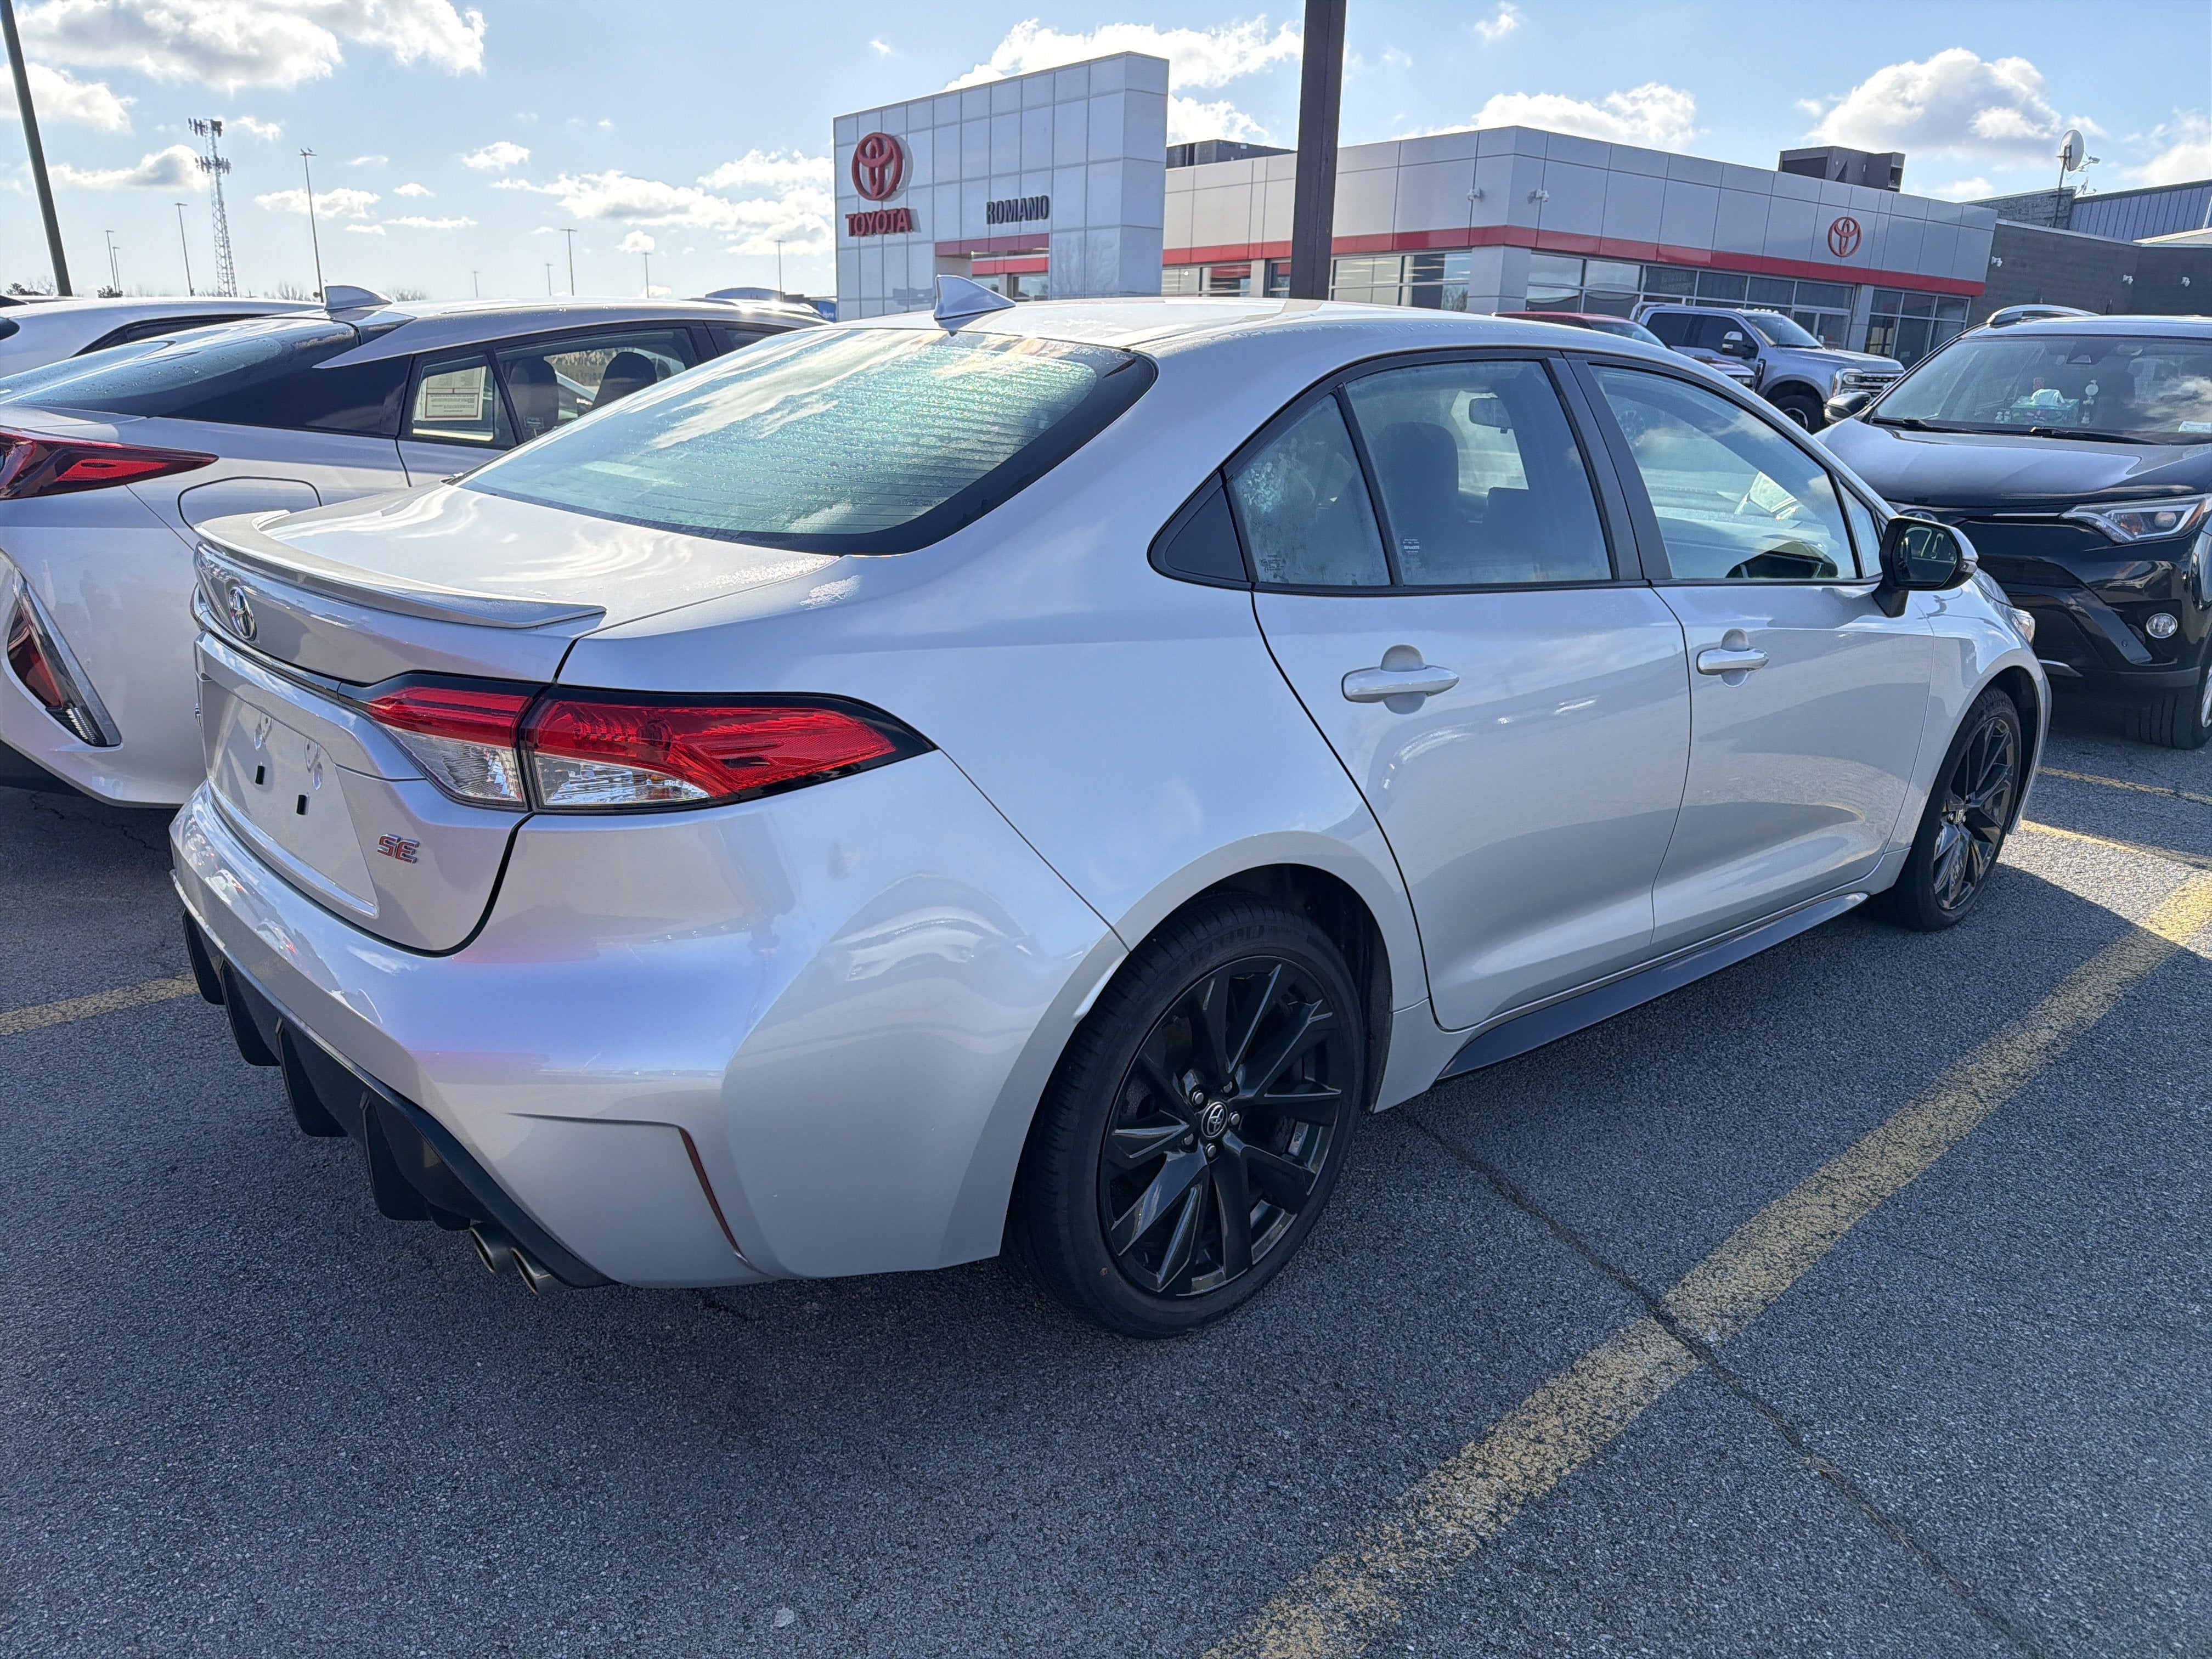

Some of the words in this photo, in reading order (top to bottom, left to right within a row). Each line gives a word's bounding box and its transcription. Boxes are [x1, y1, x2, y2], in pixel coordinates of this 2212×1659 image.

[845, 208, 912, 236] TOYOTA
[986, 195, 1049, 224] ROMANO
[377, 833, 420, 864] SE
